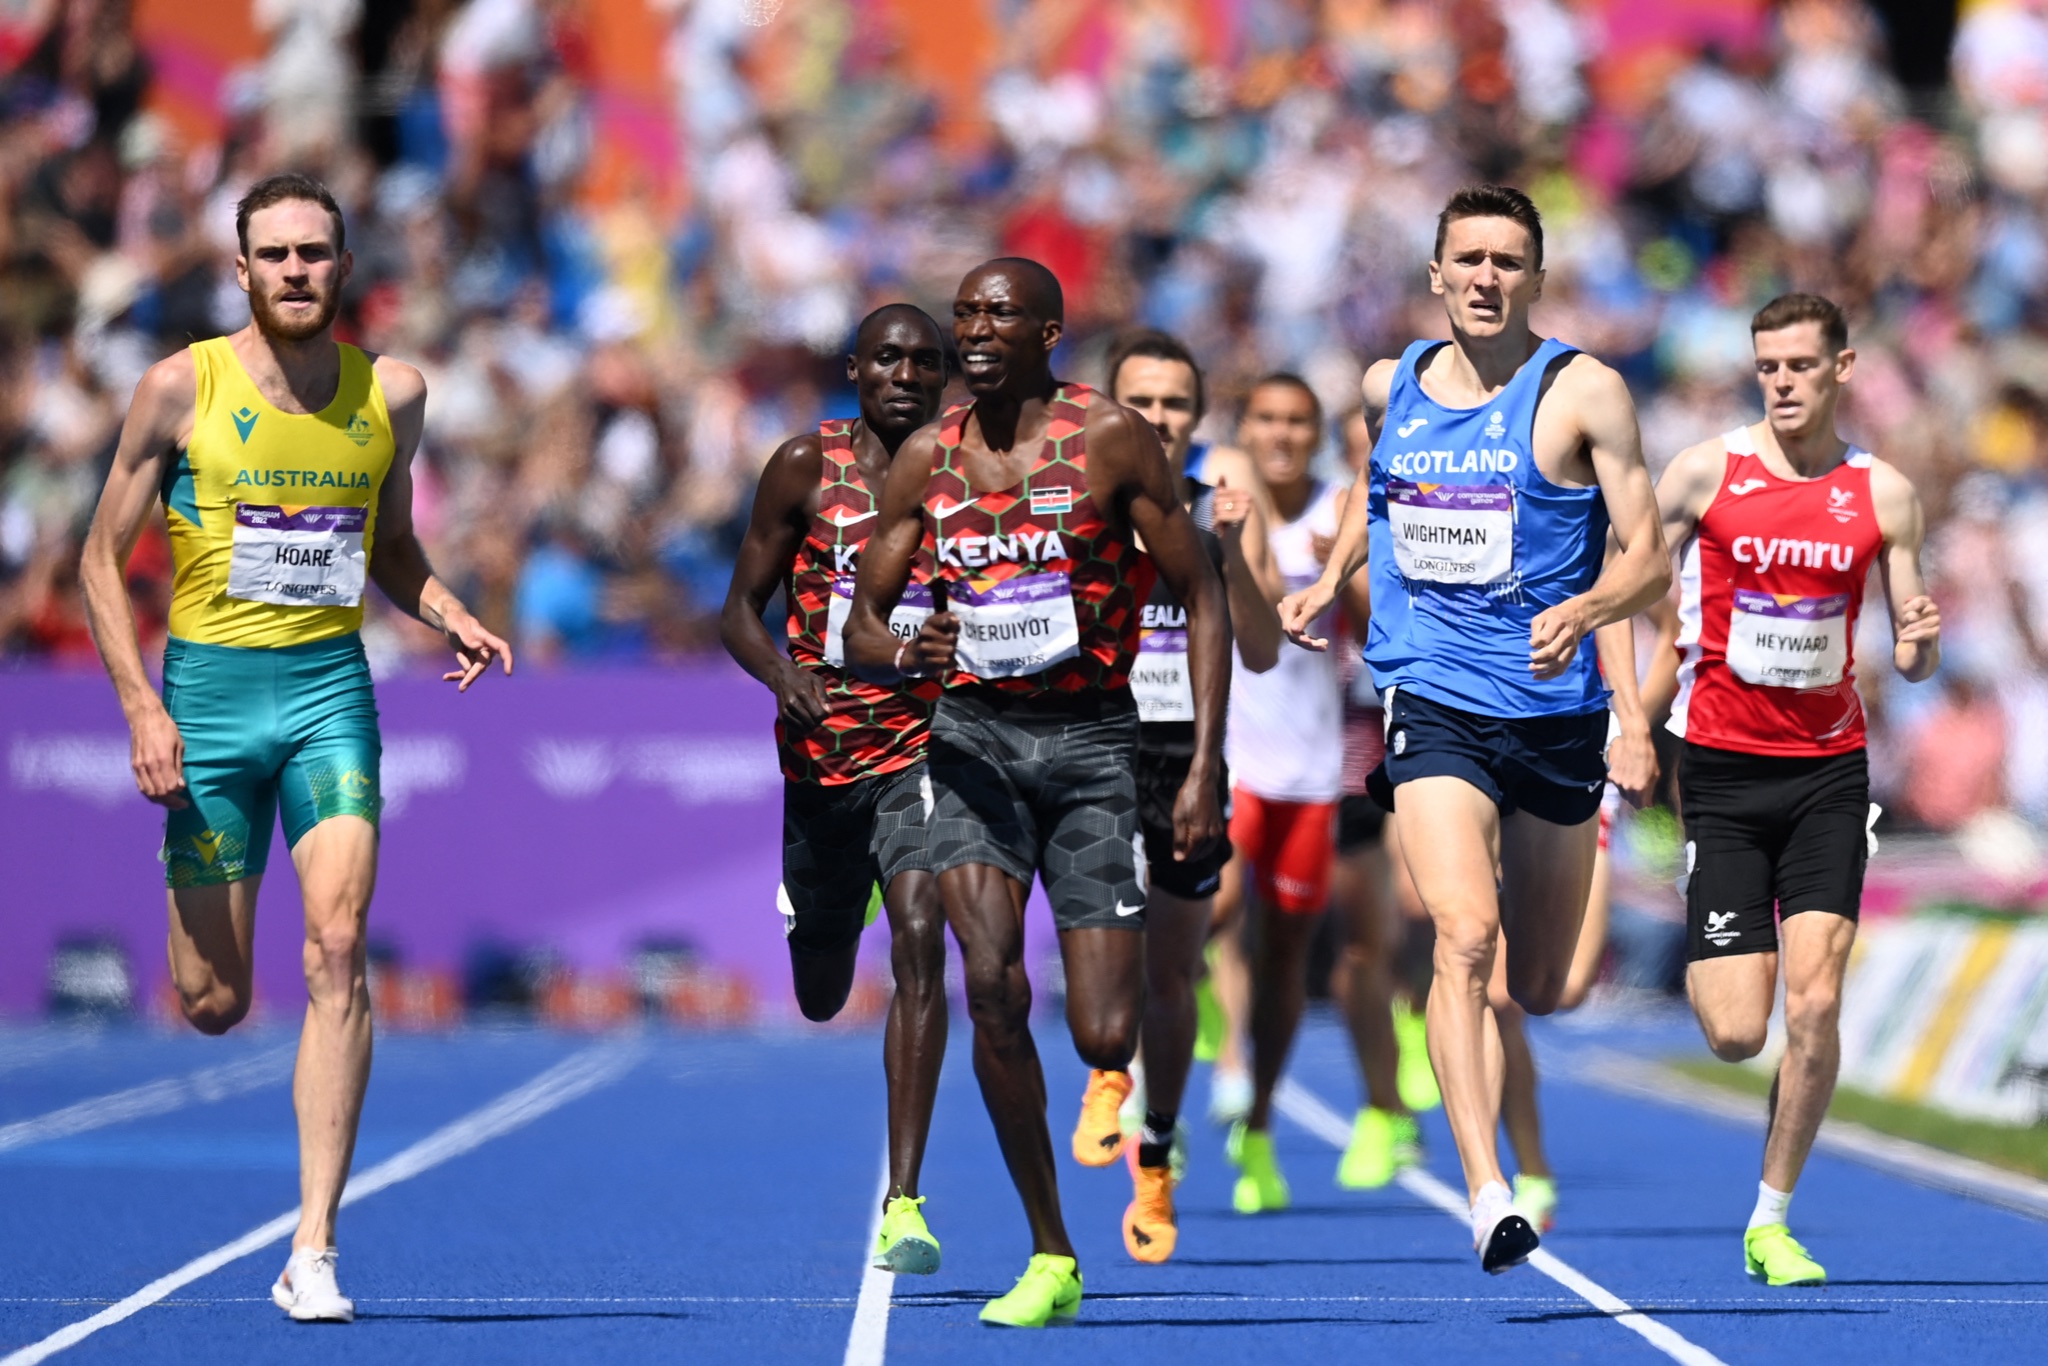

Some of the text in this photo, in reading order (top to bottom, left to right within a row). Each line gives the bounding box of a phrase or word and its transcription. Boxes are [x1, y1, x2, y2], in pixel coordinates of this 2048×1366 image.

[1388, 449, 1518, 476] SCOTLAND
[234, 469, 370, 489] AUSTRALIA
[251, 516, 268, 524] 2022
[1403, 522, 1487, 546] WIGHTMAN
[274, 546, 334, 567] HOARE
[935, 530, 1068, 568] KENYA
[1731, 535, 1854, 574] cymru
[1413, 558, 1476, 574] LONGINES
[264, 580, 337, 595] LONGINES
[1139, 604, 1188, 628] EALA
[891, 622, 922, 640] SAN
[1755, 632, 1829, 654] HEYWARD
[1129, 668, 1180, 687] ANNER
